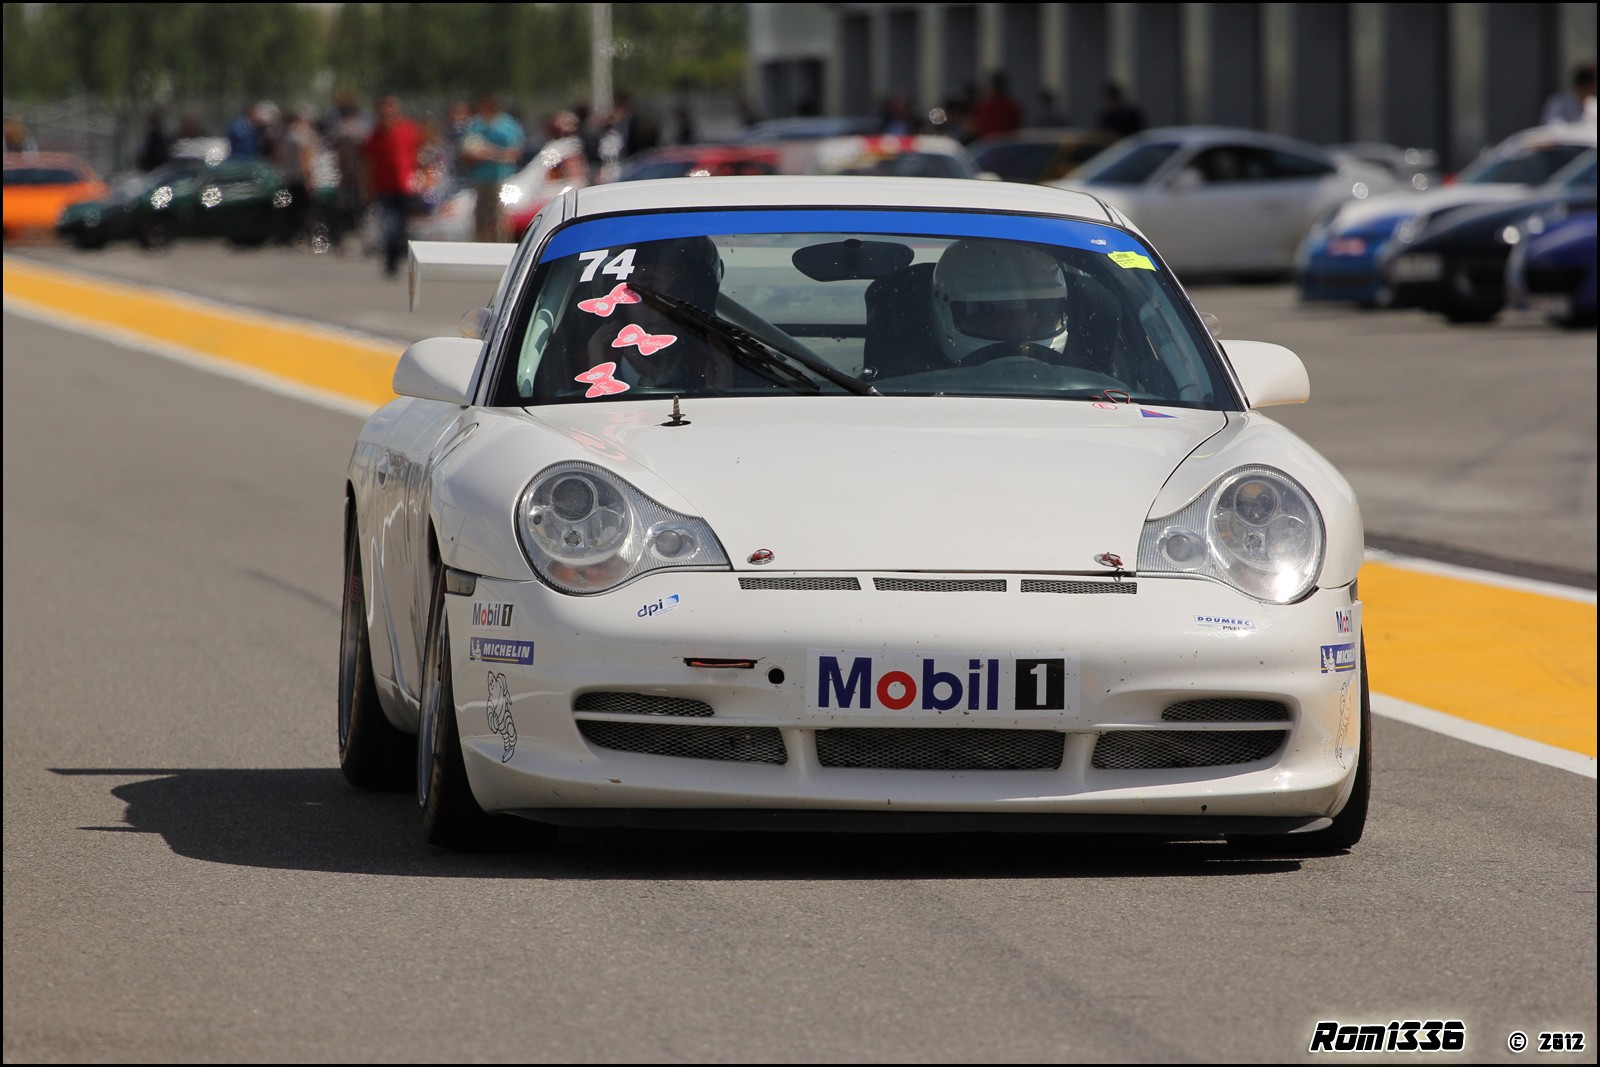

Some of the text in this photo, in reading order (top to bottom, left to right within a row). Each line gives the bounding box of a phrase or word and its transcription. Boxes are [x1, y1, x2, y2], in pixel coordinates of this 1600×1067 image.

[578, 249, 637, 283] 74
[472, 603, 501, 626] Mobil
[637, 598, 664, 617] dpi
[1197, 616, 1250, 626] DOUMERC
[482, 643, 531, 658] MICHELIN
[818, 656, 999, 710] Mobil
